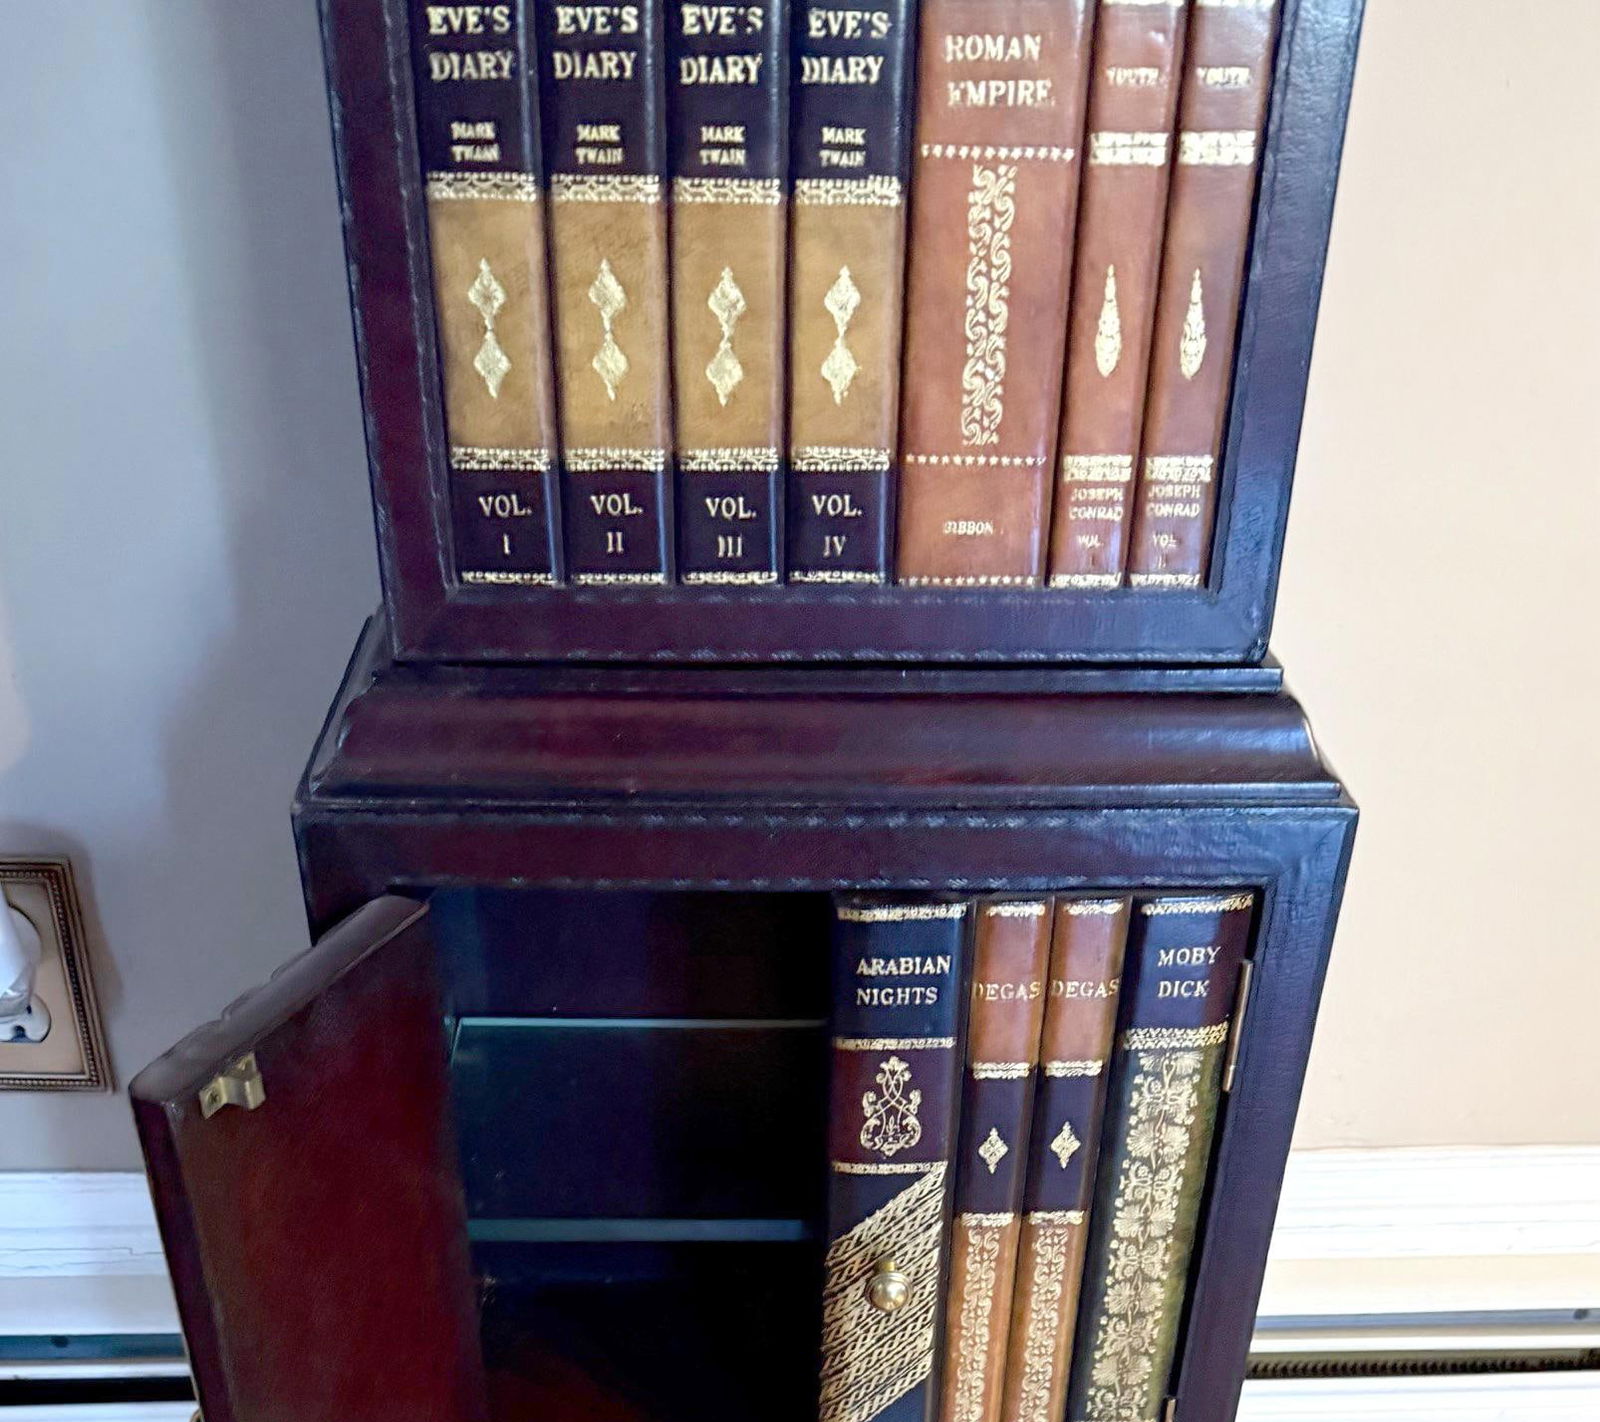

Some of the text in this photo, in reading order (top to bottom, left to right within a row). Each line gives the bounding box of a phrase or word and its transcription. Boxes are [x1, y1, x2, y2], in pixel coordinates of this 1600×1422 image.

[426, 4, 512, 35] EVE'S
[556, 5, 639, 35] EVE'S
[681, 4, 764, 35] EVE'S
[808, 7, 890, 39] EVE'S
[944, 33, 1042, 63] ROMAN
[430, 51, 513, 82] DIARY
[553, 51, 637, 82] DIARY
[680, 53, 762, 85] DIARY
[801, 55, 884, 85] DIARY
[451, 121, 496, 141] MARK
[576, 124, 622, 143] MARK
[701, 125, 746, 143] MARK
[821, 126, 866, 146] MARK
[451, 143, 500, 163] TWAIN
[575, 146, 624, 165] TWAIN
[700, 147, 747, 166] TWAIN
[819, 149, 867, 168] TWAIN
[1147, 484, 1201, 498] JOSEPH
[478, 494, 533, 518] VOL.
[590, 493, 644, 516] VOL.
[706, 497, 757, 520] VOL.
[812, 493, 863, 518] VOL.
[1069, 505, 1123, 521] CONRAD
[1146, 502, 1200, 518] CONRAD
[502, 533, 511, 555] I
[606, 531, 625, 553] II
[718, 534, 743, 558] III
[823, 535, 847, 557] IV
[855, 955, 952, 977] ARABIAN
[1158, 946, 1221, 967] MOBY
[856, 987, 939, 1007] NIGHTS
[974, 980, 1042, 1001] DEGAS
[1051, 978, 1120, 1000] DEGAS
[1158, 979, 1210, 999] DICK
